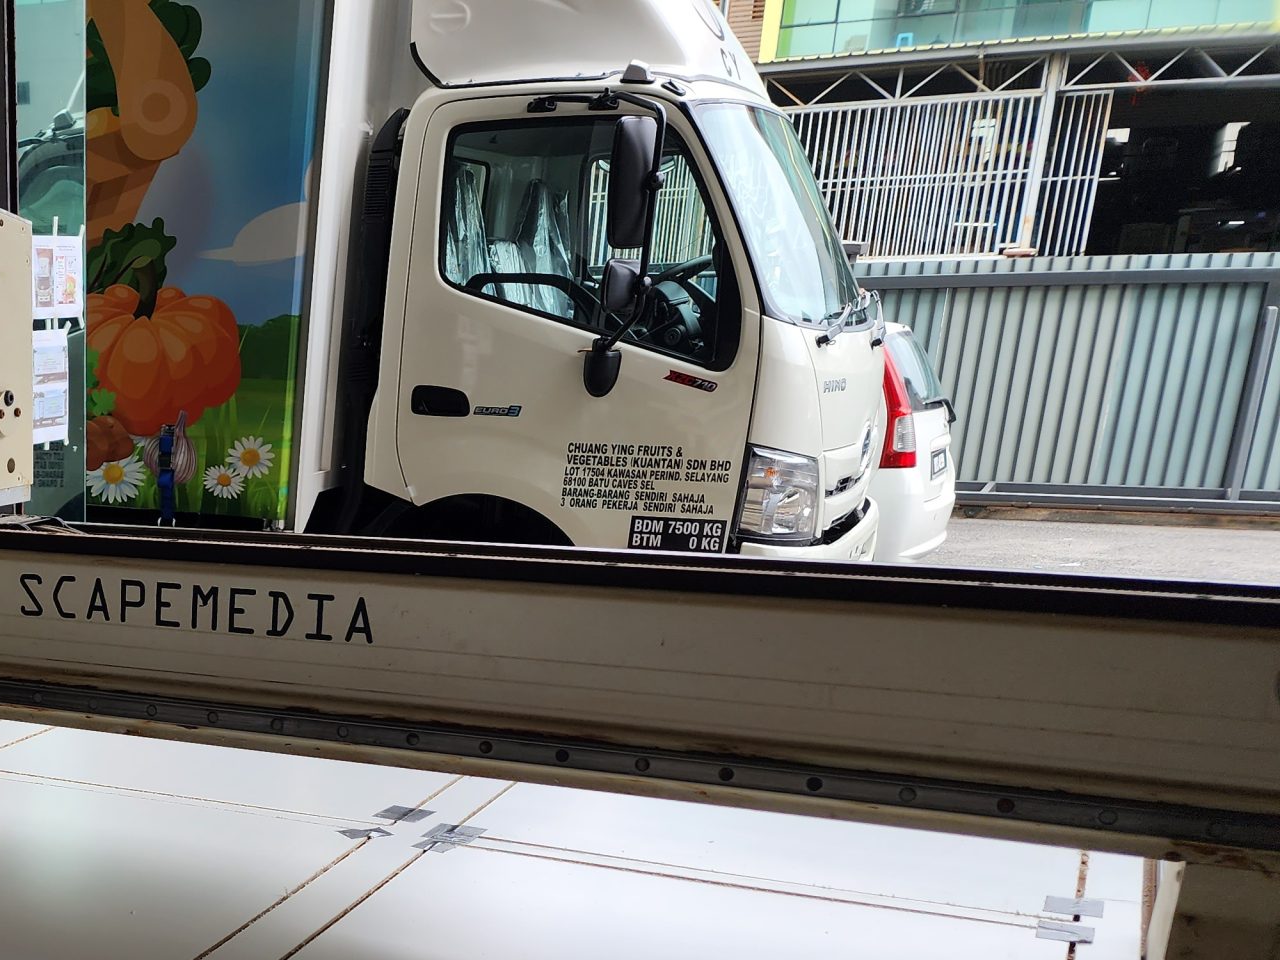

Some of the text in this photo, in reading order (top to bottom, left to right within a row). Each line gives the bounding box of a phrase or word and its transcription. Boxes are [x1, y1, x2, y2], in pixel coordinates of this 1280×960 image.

[823, 378, 846, 393] HINO
[568, 442, 683, 457] CHUANG YING FRUITS &
[567, 454, 731, 471] VEGETABLES (KUANTAN) SDN BHD
[565, 466, 580, 476] LOT
[582, 467, 604, 477] 17504
[607, 468, 647, 479] KAWASAN
[685, 472, 729, 483] SELAYANG
[563, 477, 655, 490] 68100 BATU CAVES SEL
[562, 488, 705, 504] BARANG-BARANG SENDIRI SAHAJA
[560, 497, 714, 514] 3 ORANG PEKERJA SENDIRI SAHAJA
[634, 519, 723, 537] BDM 7500 KG
[632, 534, 720, 551] BTM 0 KG
[19, 573, 375, 645] SCAPEMEDIA
